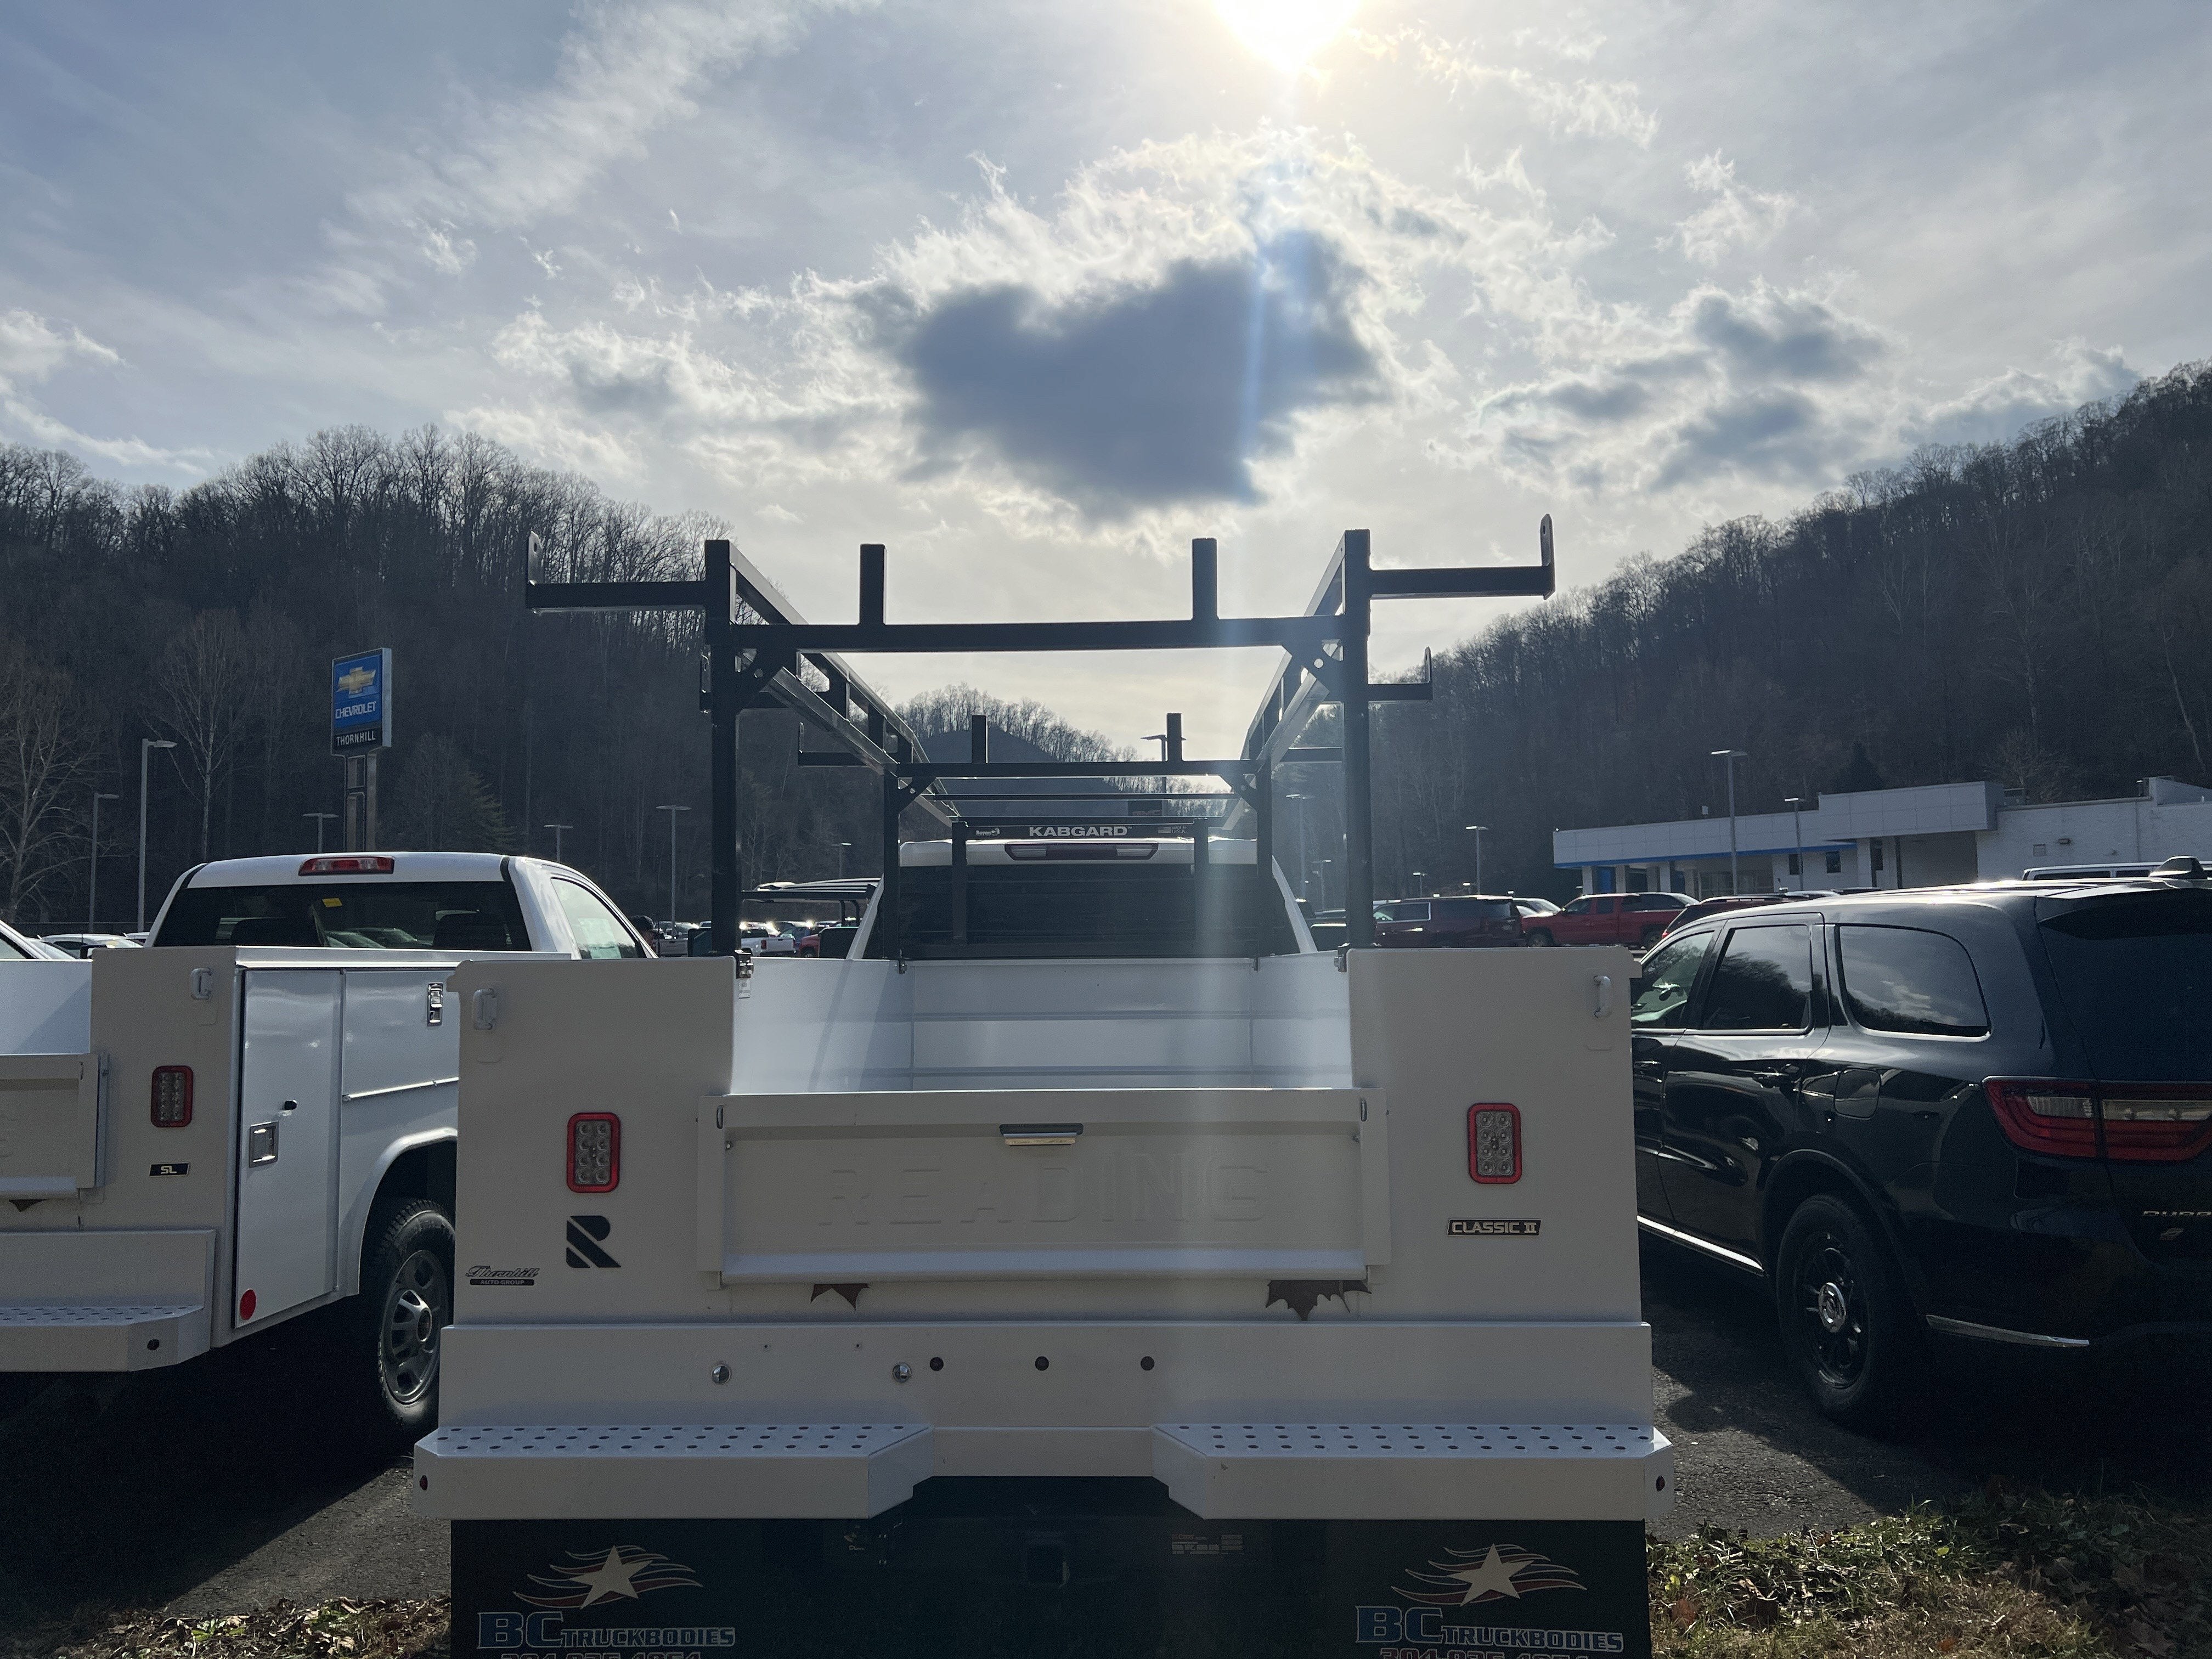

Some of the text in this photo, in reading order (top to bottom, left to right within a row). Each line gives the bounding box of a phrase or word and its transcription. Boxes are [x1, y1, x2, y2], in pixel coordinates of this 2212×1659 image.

[335, 701, 376, 719] CHEVROLET
[336, 730, 376, 747] THORNHILL
[1029, 826, 1128, 837] KABGARD
[161, 1165, 177, 1174] SL
[817, 1154, 1268, 1225] READING
[1452, 1222, 1537, 1233] CLASSIC II
[465, 1265, 540, 1278] Thornhill
[477, 1611, 564, 1649] BC
[1355, 1606, 1443, 1644] BC
